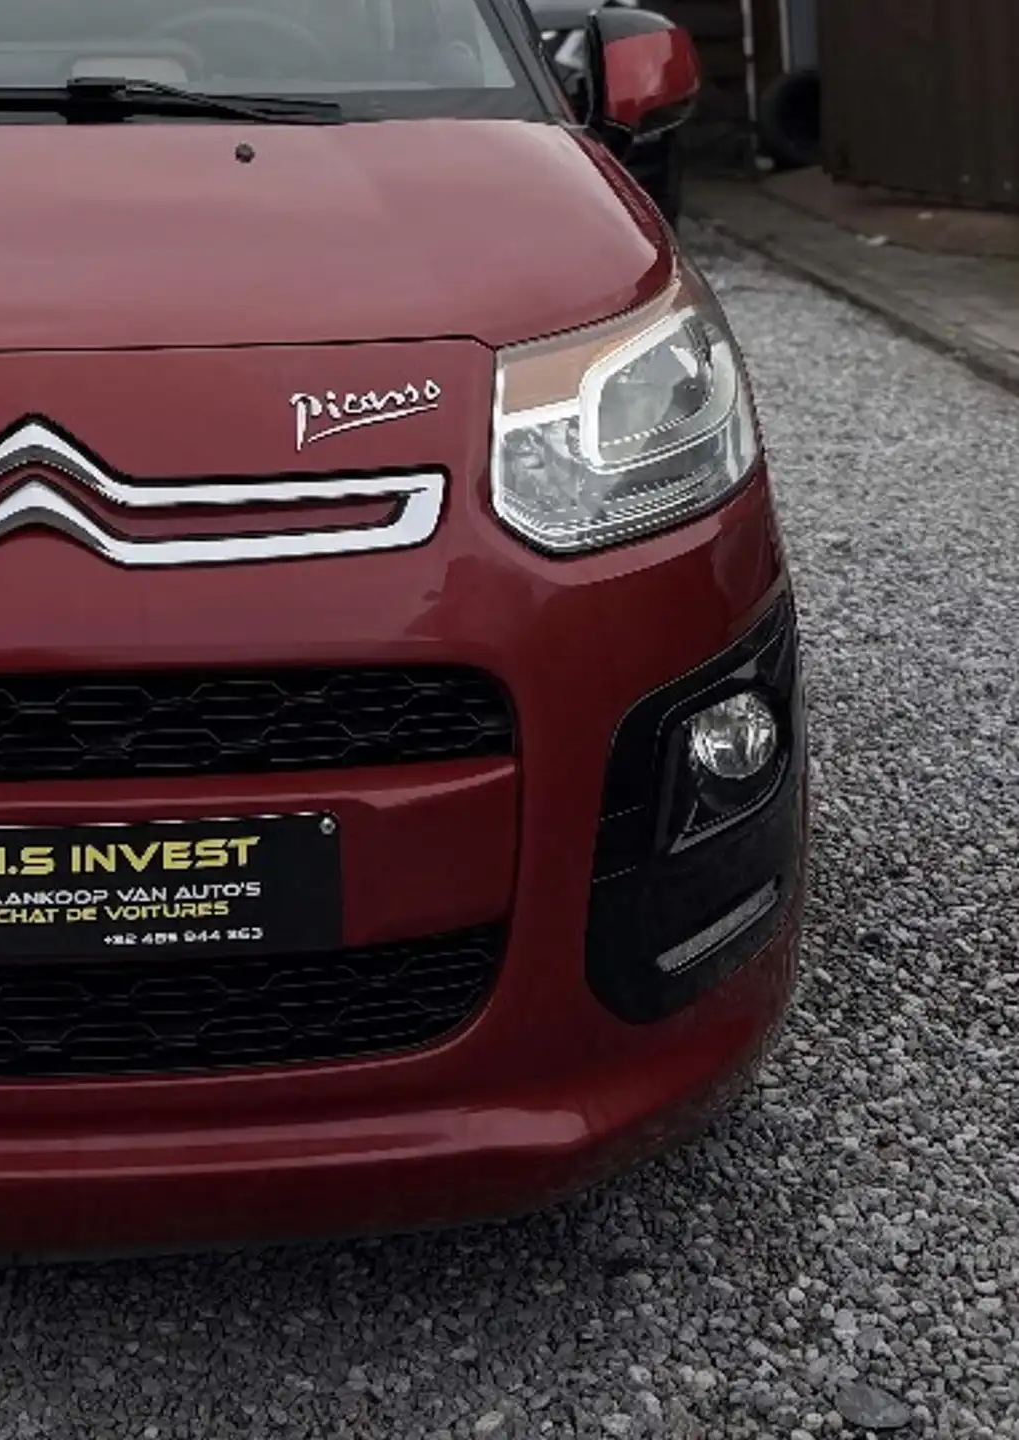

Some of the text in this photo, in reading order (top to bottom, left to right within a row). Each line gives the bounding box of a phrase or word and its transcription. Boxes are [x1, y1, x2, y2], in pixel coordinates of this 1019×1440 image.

[71, 836, 261, 873] INVEST
[116, 886, 167, 902] VAN
[173, 881, 261, 901] AUTO'S
[65, 906, 97, 922] DE
[104, 900, 230, 921] VOITURES
